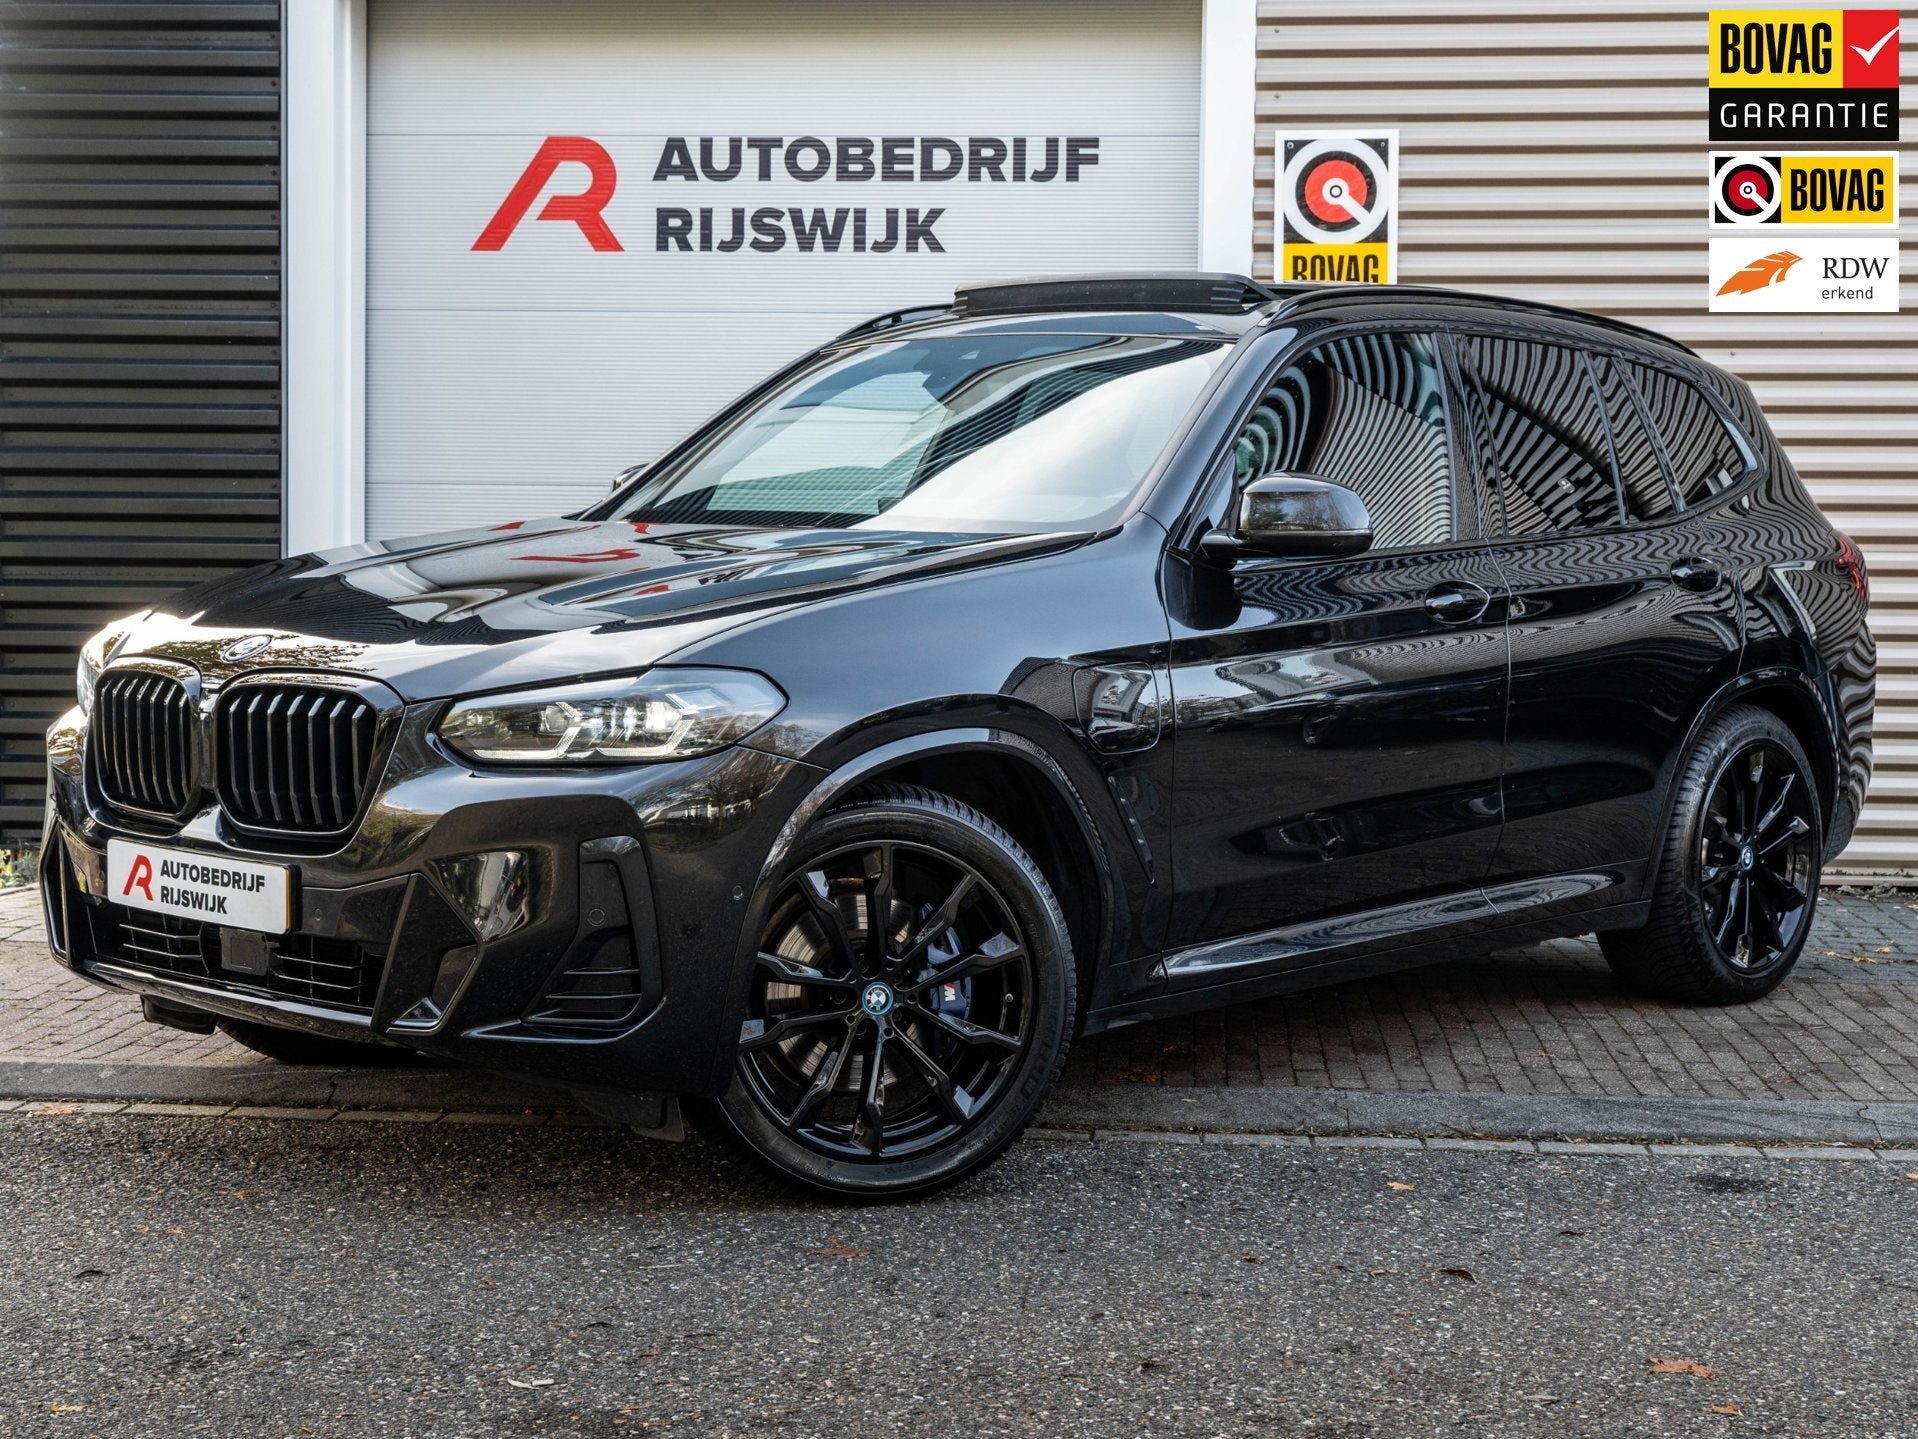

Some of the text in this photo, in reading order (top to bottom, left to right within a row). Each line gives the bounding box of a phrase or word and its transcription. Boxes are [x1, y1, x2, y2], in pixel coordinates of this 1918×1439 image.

[653, 136, 1101, 183] AUTOBEDRIJF
[656, 207, 946, 253] RIJSWIJK
[1292, 254, 1379, 283] BOVAG
[160, 860, 265, 893] AUTOBEDRIJF
[160, 885, 228, 914] RIJSWIJK
